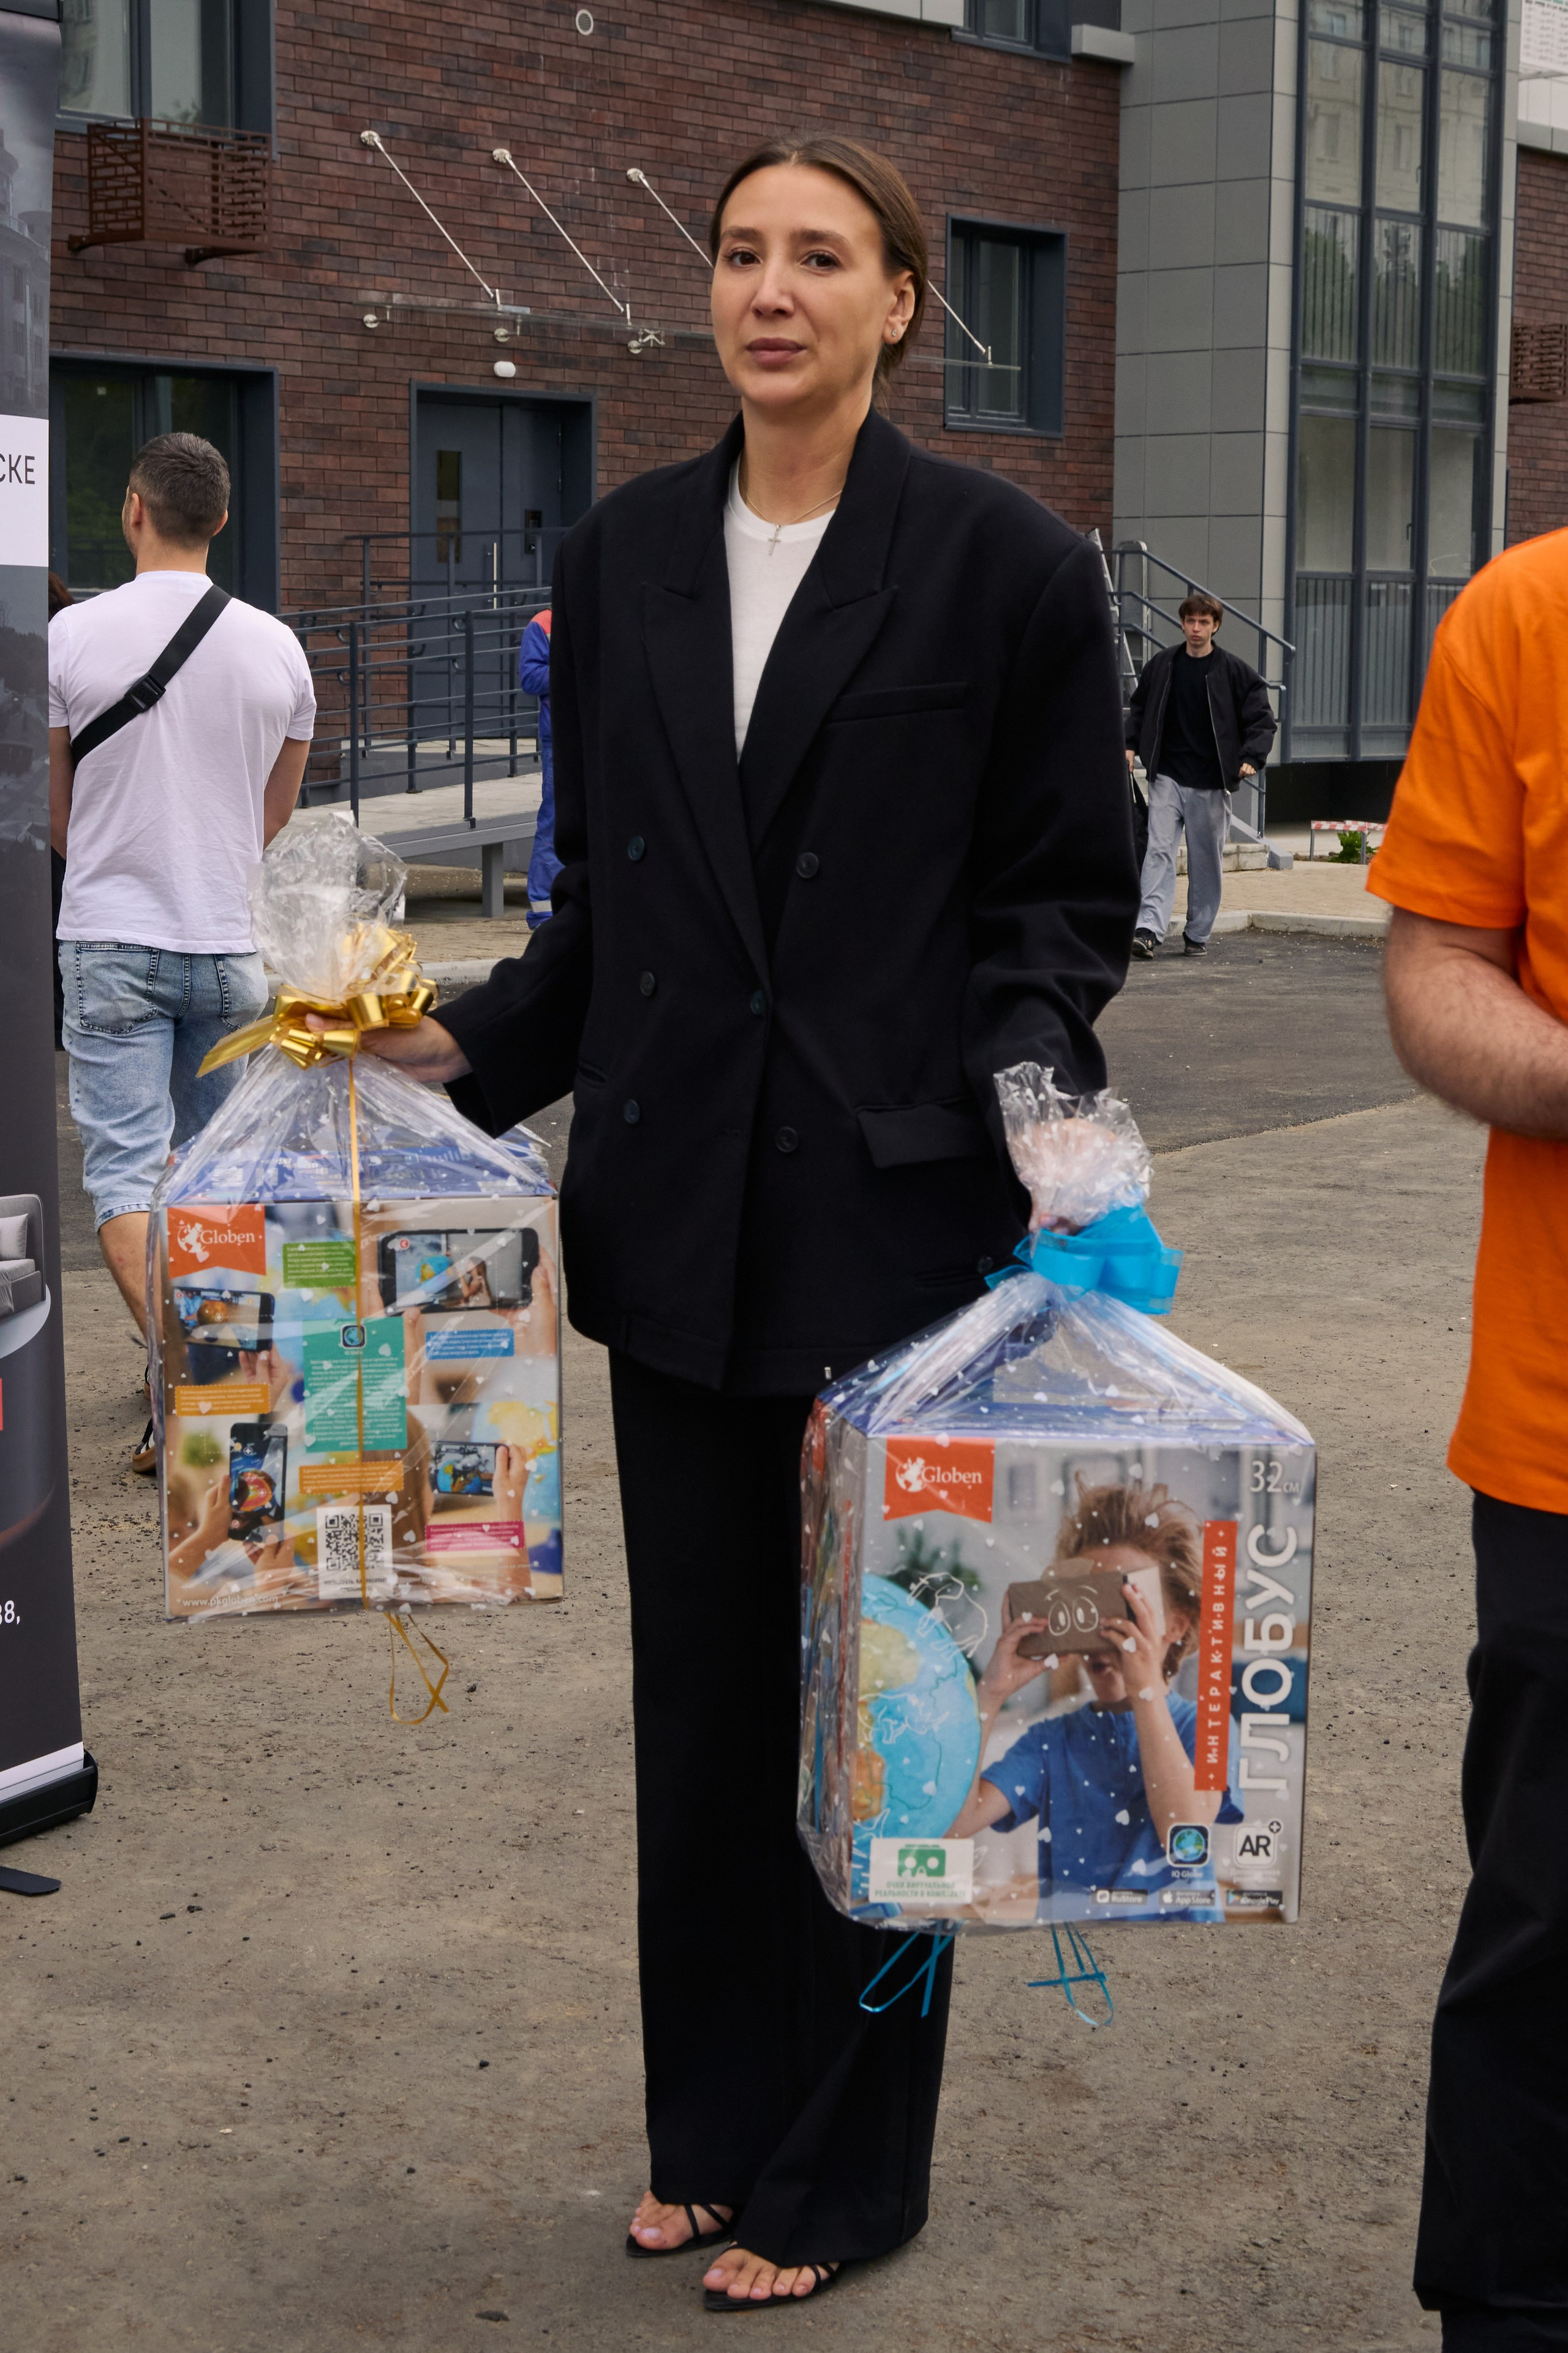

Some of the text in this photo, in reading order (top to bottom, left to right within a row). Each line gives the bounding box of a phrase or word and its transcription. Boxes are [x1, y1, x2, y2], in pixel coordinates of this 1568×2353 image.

[200, 1229, 255, 1244] Globen
[921, 1466, 982, 1484] Globen
[1250, 1461, 1282, 1492] 32
[0, 1600, 20, 1625] 8,
[1207, 1546, 1228, 1764] ИНТЕРАКТИВНЫЙ
[1238, 1524, 1298, 1789] ГЛОБУС
[1238, 1835, 1271, 1857] AR
[1175, 1896, 1191, 1905] App
